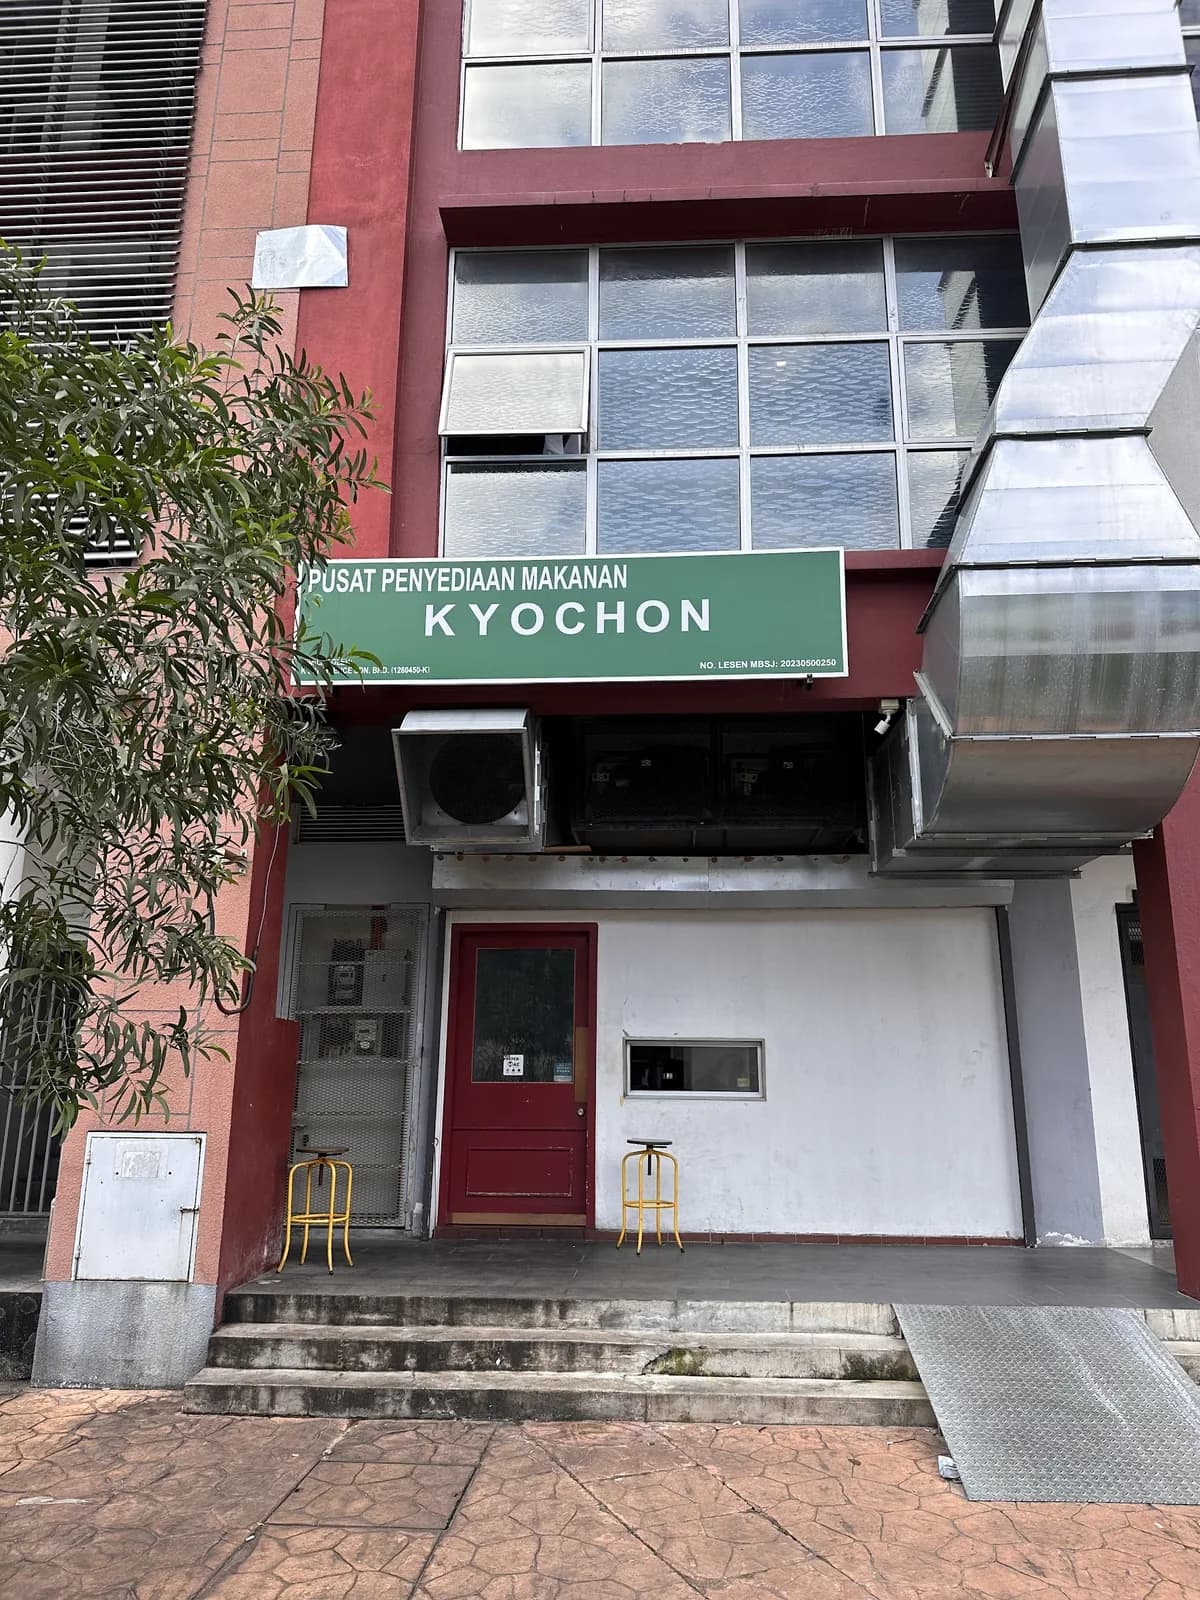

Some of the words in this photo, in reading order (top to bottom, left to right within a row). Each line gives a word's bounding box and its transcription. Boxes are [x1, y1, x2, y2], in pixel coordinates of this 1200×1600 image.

[307, 568, 377, 593] PUSAT
[381, 566, 515, 592] PENYEDIAAN
[521, 564, 628, 591] MAKANAN
[424, 598, 710, 637] KYOCHON
[699, 661, 716, 670] NO.
[718, 660, 748, 669] LESEN
[750, 659, 778, 668] MBSJ:
[780, 658, 837, 668] 20230500250
